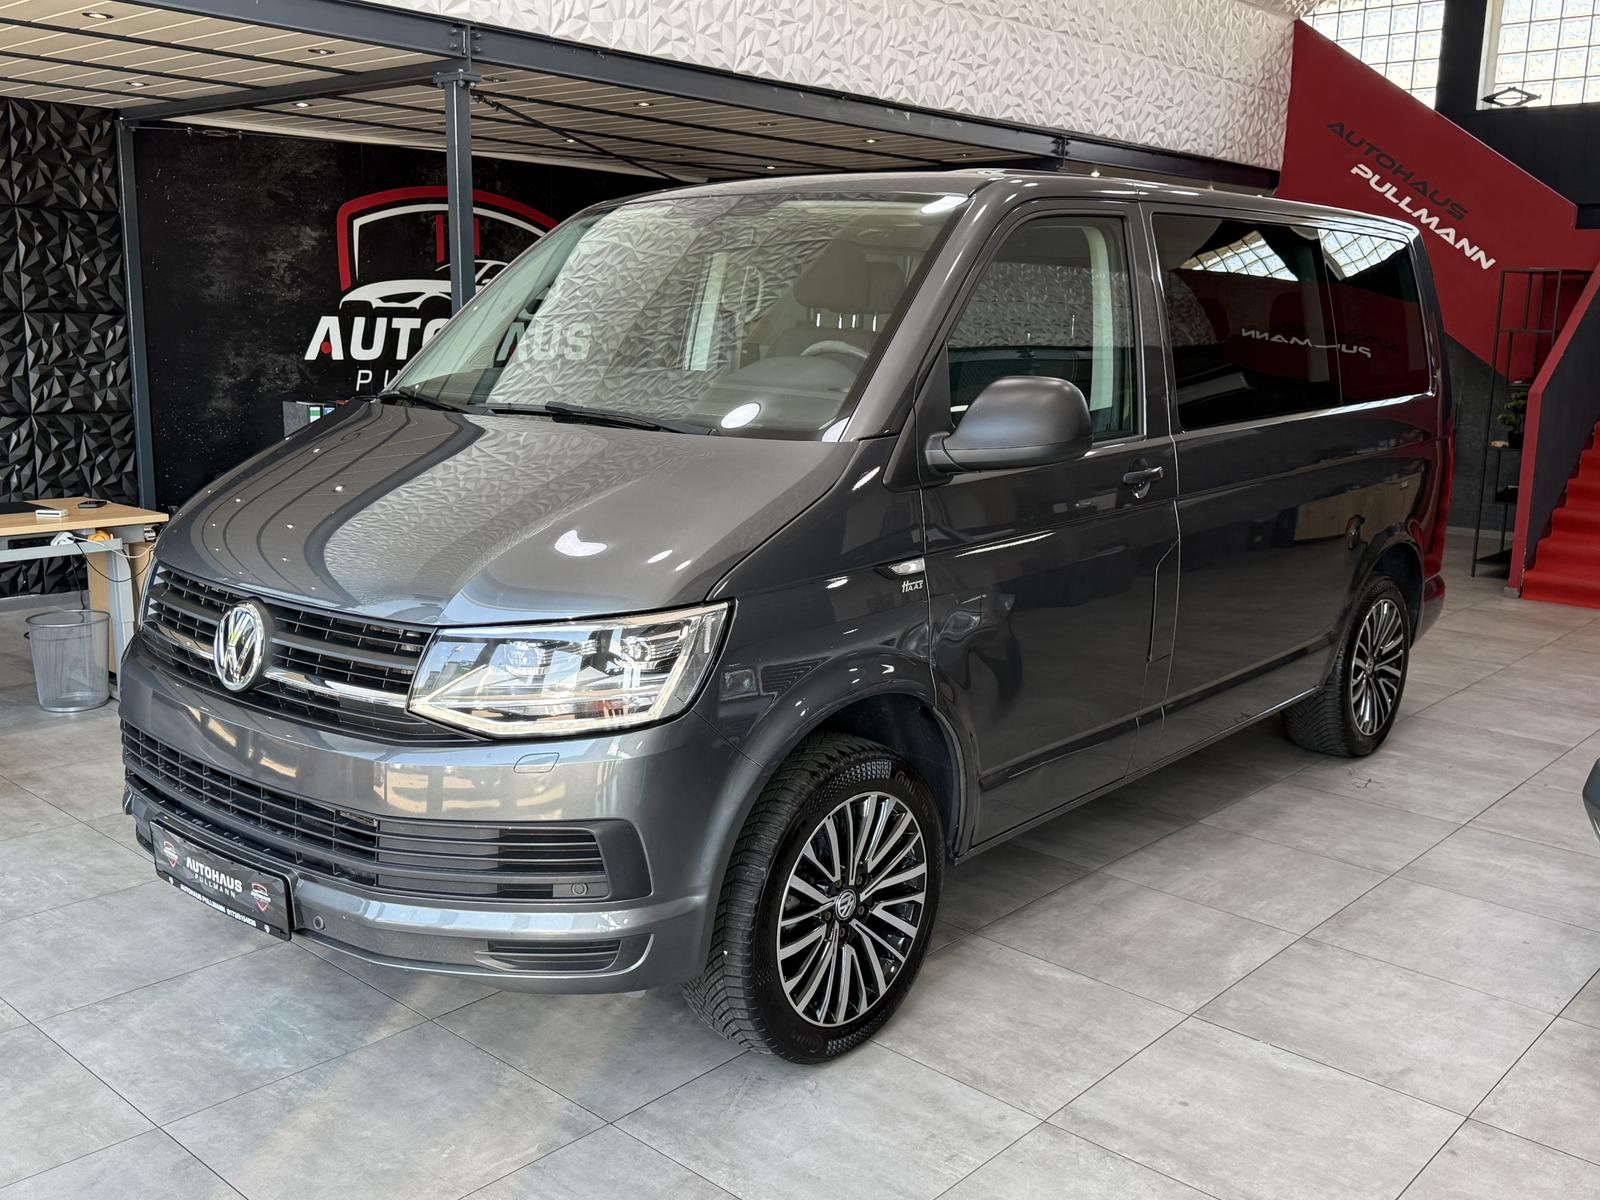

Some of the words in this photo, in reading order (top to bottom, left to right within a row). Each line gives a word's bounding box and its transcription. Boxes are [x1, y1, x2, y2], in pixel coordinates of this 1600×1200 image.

[1326, 121, 1468, 221] AUTOHAUS
[1350, 163, 1496, 270] PULLMANN
[186, 856, 243, 893] AUTOHAUS
[194, 873, 236, 899] PULLMANN
